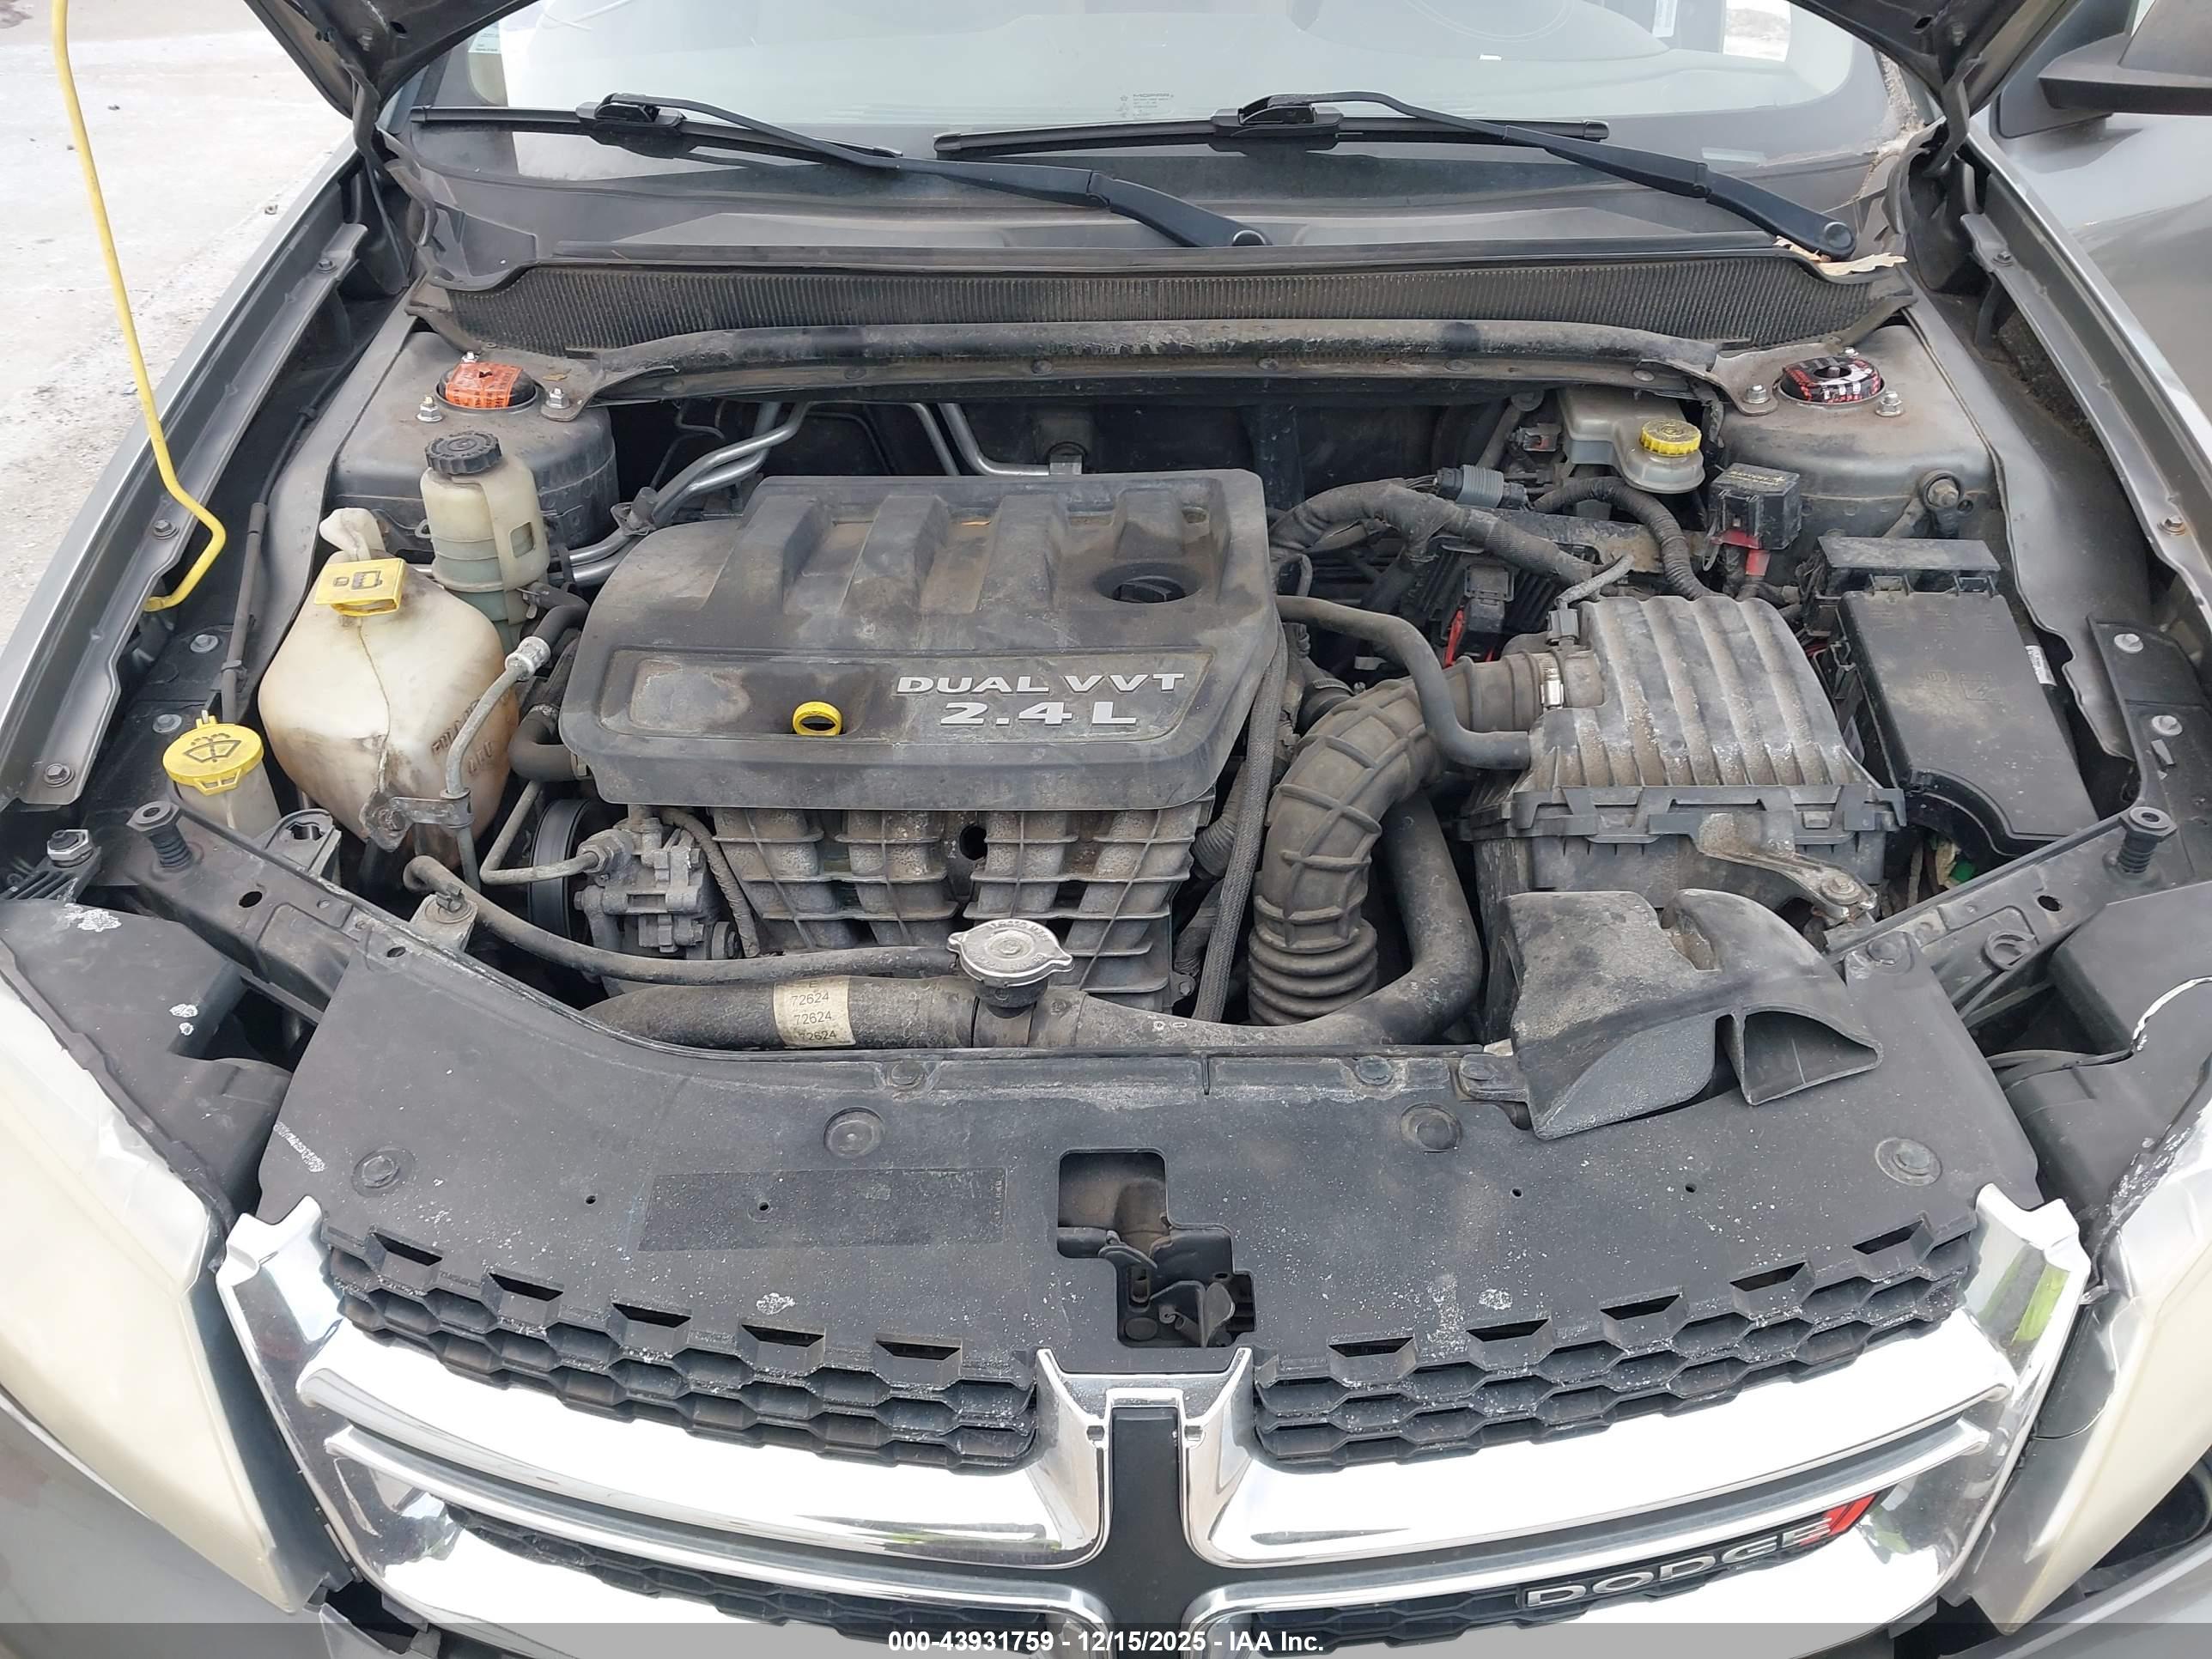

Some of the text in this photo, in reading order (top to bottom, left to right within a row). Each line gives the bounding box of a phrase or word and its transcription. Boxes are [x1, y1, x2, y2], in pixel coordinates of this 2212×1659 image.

[896, 672, 1186, 695] DUAL VVT
[939, 701, 1138, 726] 2.4 L
[791, 991, 830, 1007] 72624
[793, 1011, 832, 1025] 72624
[798, 1030, 837, 1042] 72624
[1526, 1516, 1832, 1608] DODGE
